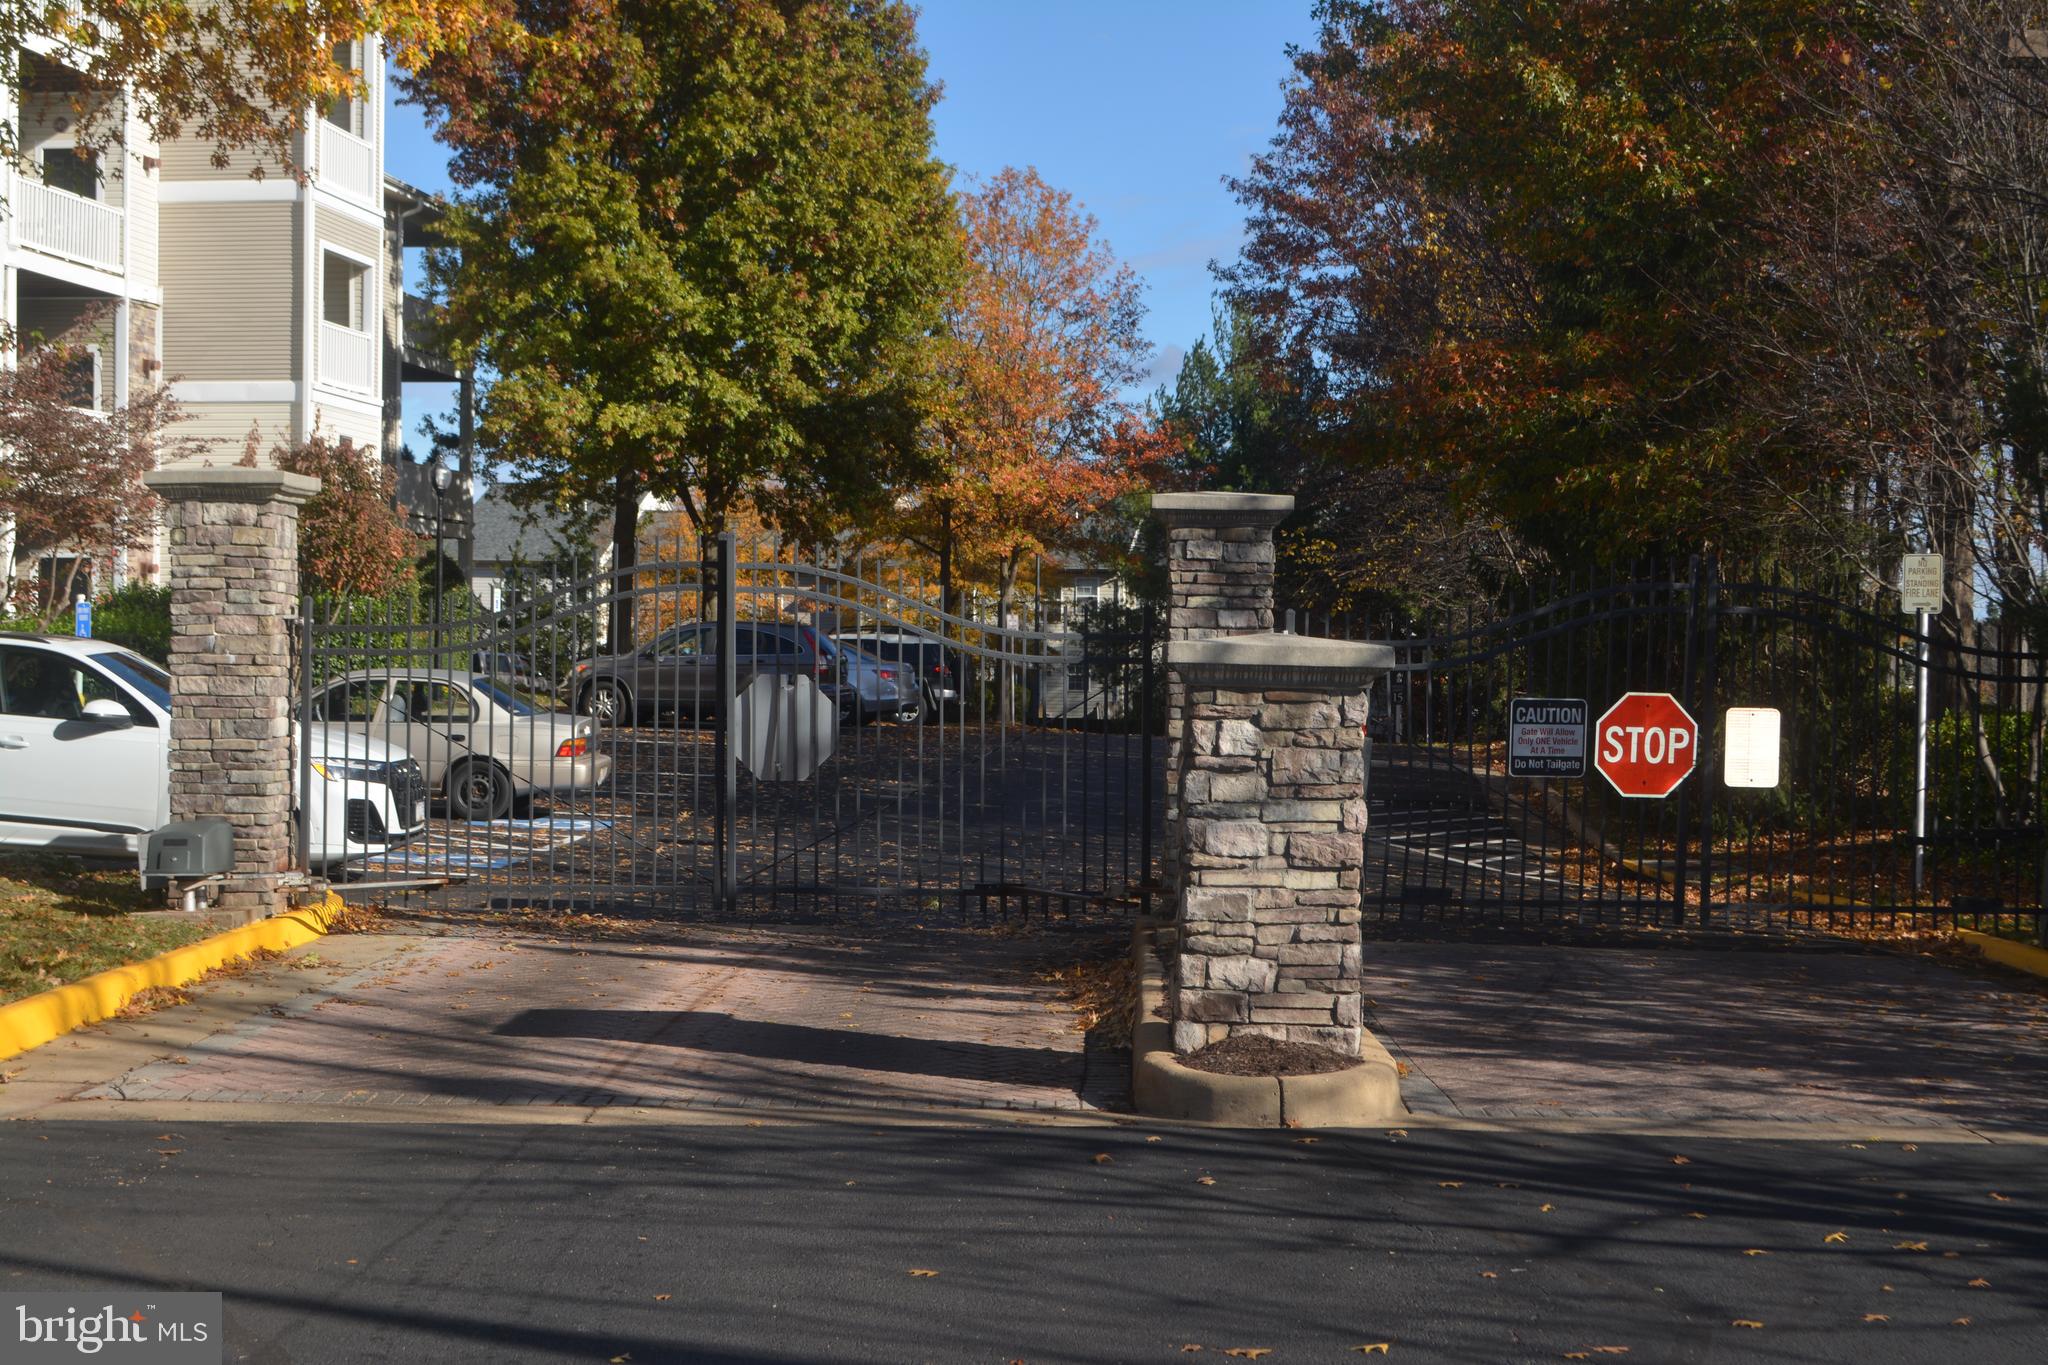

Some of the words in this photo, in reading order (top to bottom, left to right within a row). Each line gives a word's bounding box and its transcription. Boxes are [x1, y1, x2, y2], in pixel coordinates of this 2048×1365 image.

[1905, 588, 1921, 597] FIRE
[1922, 588, 1939, 597] LANE
[1393, 693, 1403, 703] 15
[1516, 706, 1582, 723] CAUTION
[1521, 728, 1538, 736] Gate
[1540, 728, 1554, 736] Will
[1554, 728, 1576, 736] Allow
[1518, 737, 1534, 746] Only
[1535, 737, 1550, 745] ONE
[1552, 737, 1578, 745] Vehicle
[1602, 725, 1690, 765] STOP
[1514, 759, 1526, 769] Do
[1528, 759, 1544, 769] Not
[1546, 759, 1581, 771] Tailgate
